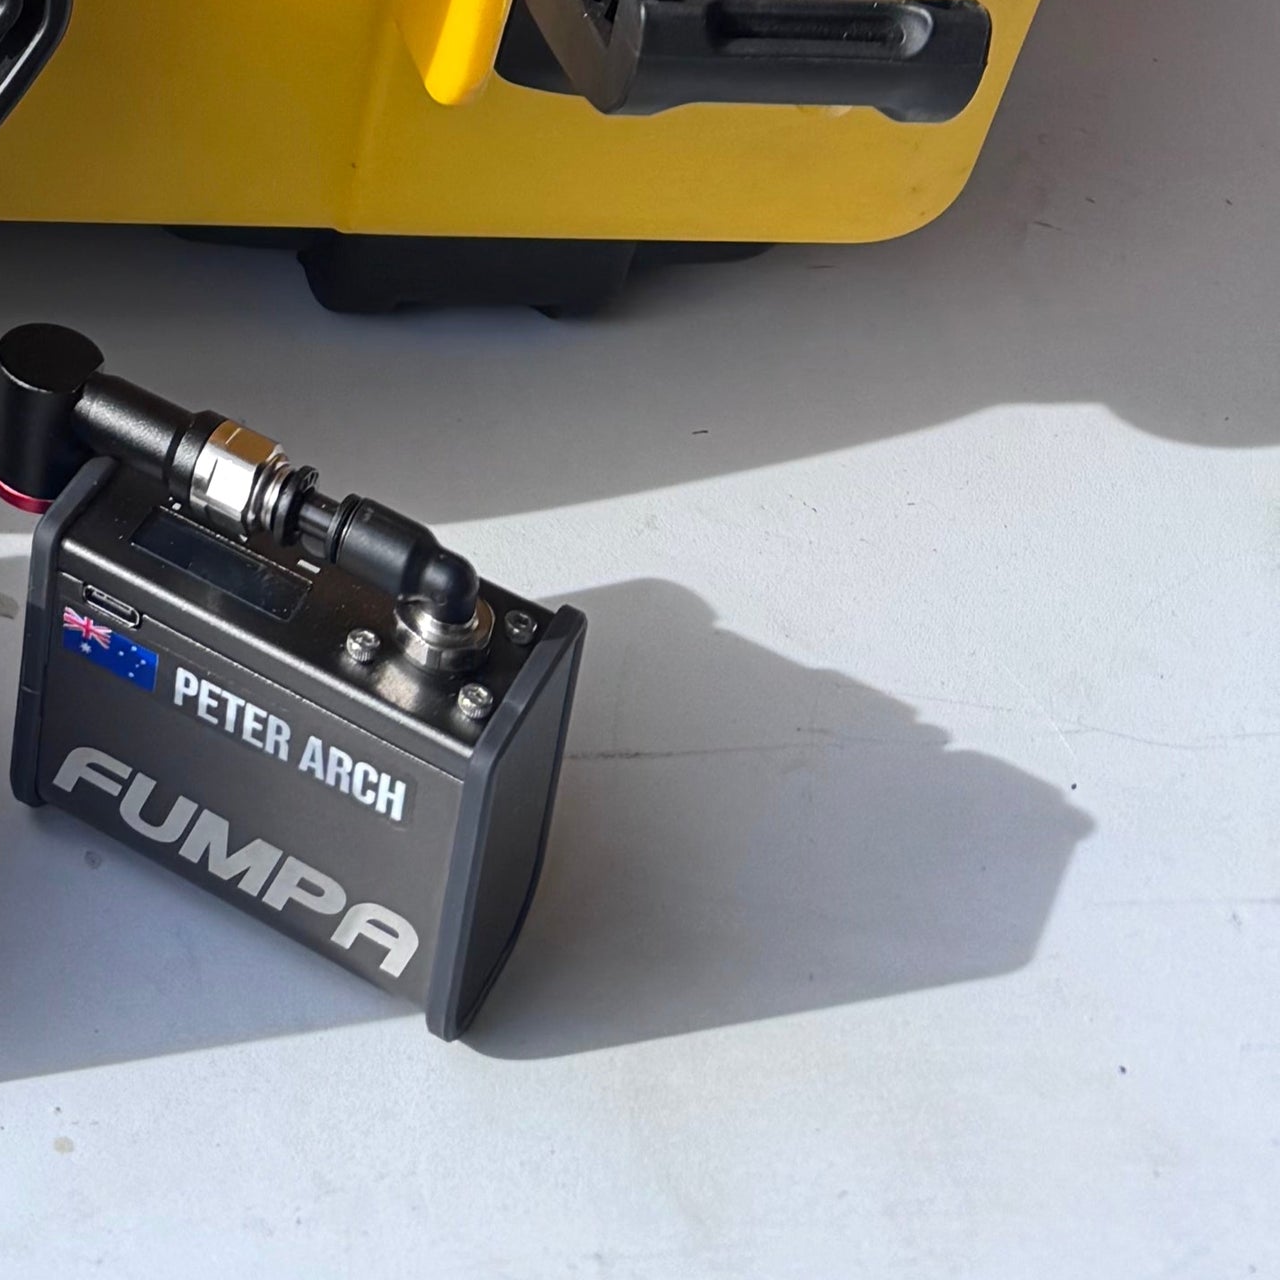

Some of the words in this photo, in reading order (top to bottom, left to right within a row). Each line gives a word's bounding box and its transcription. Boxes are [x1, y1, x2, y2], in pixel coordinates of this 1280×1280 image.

[173, 666, 292, 762] PETER
[301, 735, 406, 822] ARCH
[52, 745, 422, 978] FUMPA
